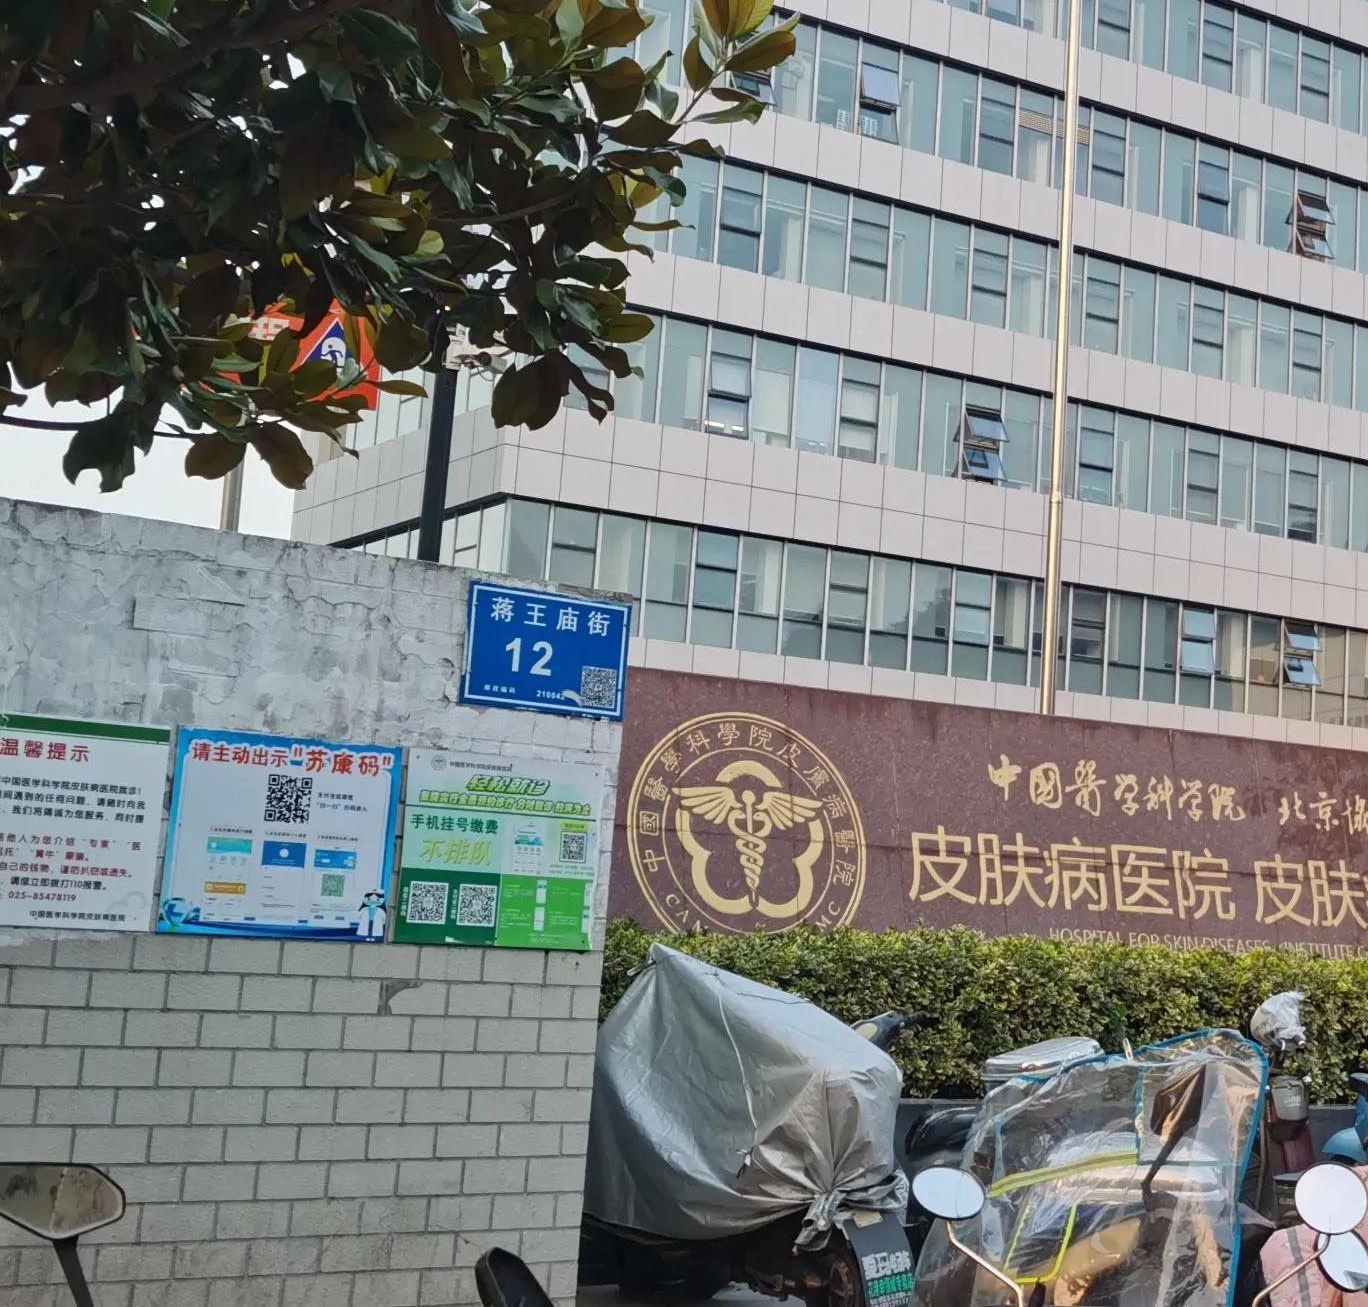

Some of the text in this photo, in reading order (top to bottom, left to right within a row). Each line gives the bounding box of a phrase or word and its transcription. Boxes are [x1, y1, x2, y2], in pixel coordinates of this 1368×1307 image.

[491, 596, 610, 637] 蒋王庙街
[505, 637, 554, 676] 12
[0, 737, 90, 762] 温馨提示
[0, 776, 141, 795] 中国医学科学院皮肤病医院就诊！
[466, 773, 550, 797] 轻松就诊
[0, 790, 146, 810] 间遇到的任何问题，请随时向我
[411, 813, 499, 835] 手机挂号缴费
[420, 837, 492, 866] 不排队
[909, 826, 1236, 921] 皮肤病医院
[1050, 927, 1123, 944] HOSPITAL
[1129, 932, 1159, 947] FOR
[1164, 934, 1198, 951] SKIN
[1202, 937, 1269, 954] DISEASES
